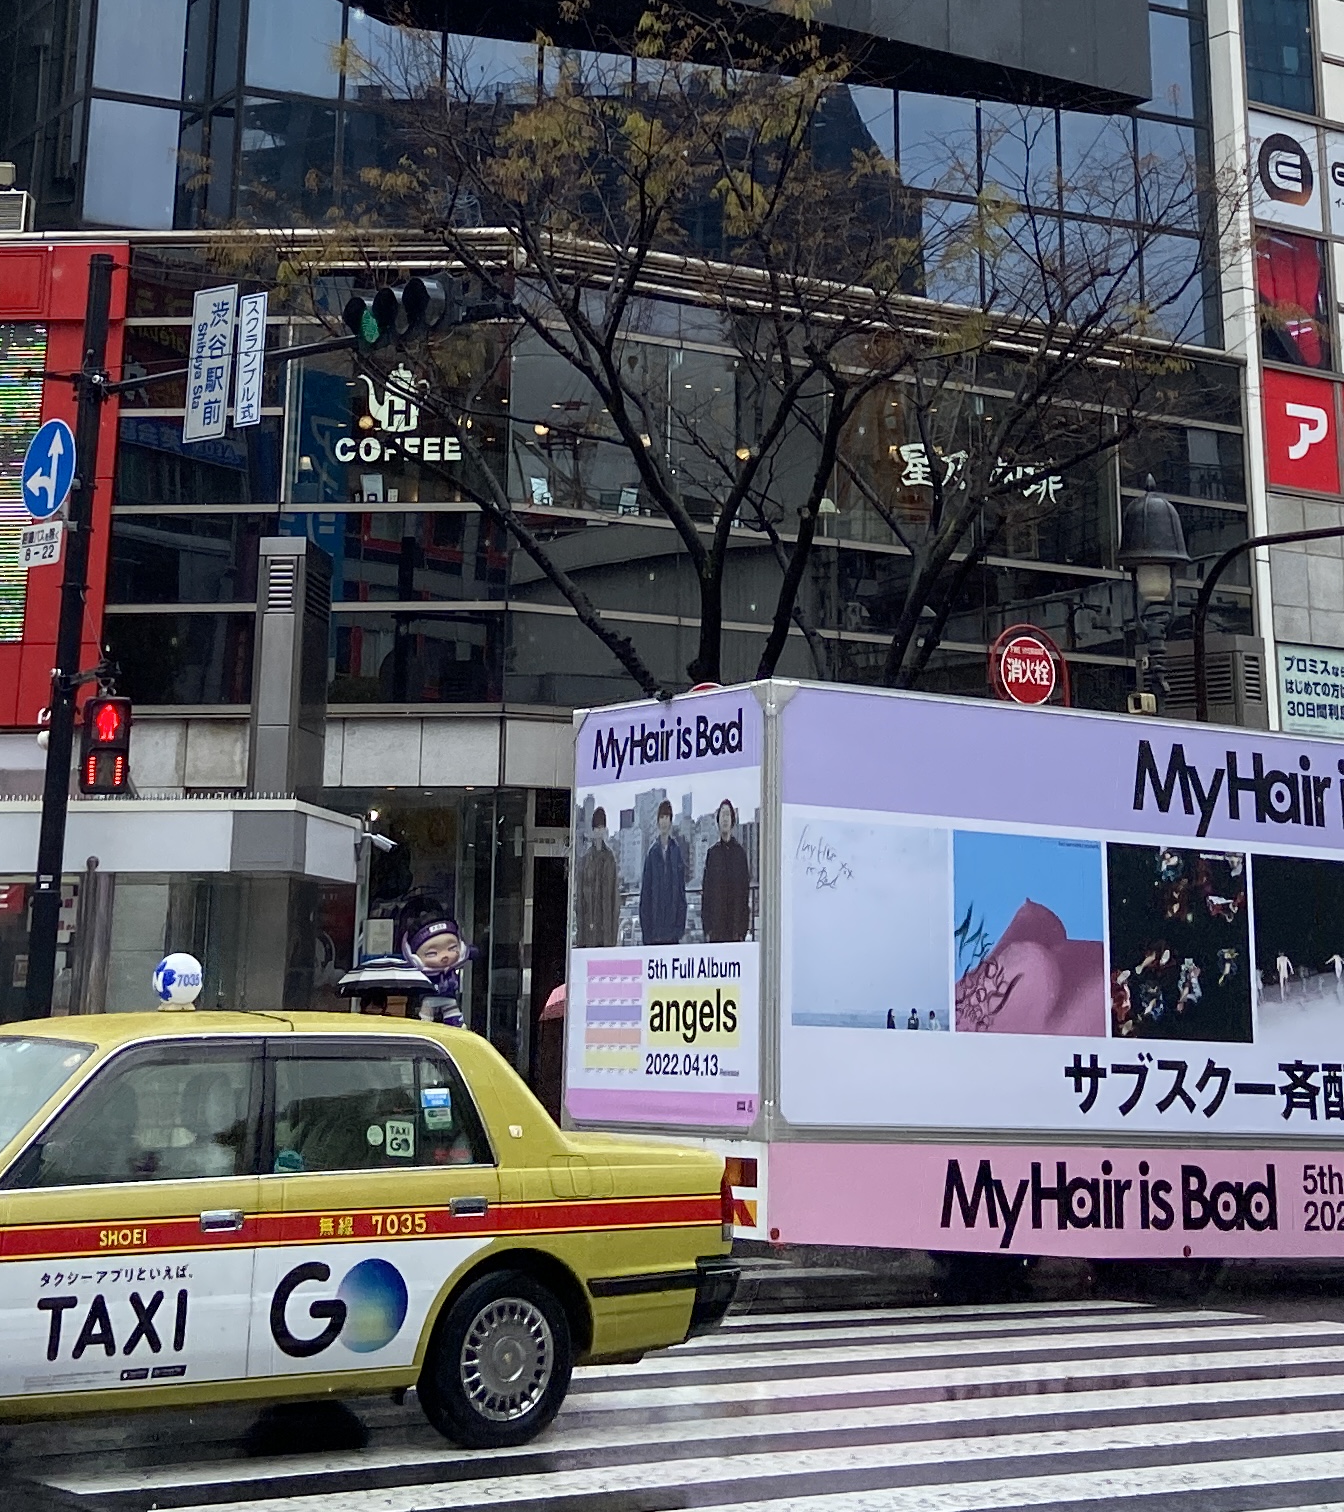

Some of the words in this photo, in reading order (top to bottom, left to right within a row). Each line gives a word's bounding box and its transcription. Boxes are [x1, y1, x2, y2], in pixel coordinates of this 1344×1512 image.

[193, 322, 209, 381] Shibuya
[202, 299, 230, 427] 渋谷駅前
[240, 300, 260, 421] スクランブル式
[335, 437, 463, 464] COFFEE
[1006, 657, 1051, 686] 消火栓
[676, 720, 693, 760] is
[696, 706, 745, 759] Bad
[176, 973, 201, 988] 7035
[646, 958, 669, 980] 5th
[671, 956, 696, 980] Full
[697, 956, 742, 980] Album
[649, 988, 738, 1044] angels
[645, 1053, 720, 1077] 2022.04.13
[389, 1125, 411, 1137] TAXI
[1302, 1164, 1344, 1195] 5th
[1139, 1159, 1176, 1232] is
[1181, 1163, 1280, 1233] Bad
[99, 1229, 148, 1248] SHOEI
[318, 1216, 355, 1237] 無線
[370, 1213, 428, 1236] 7035
[36, 1288, 189, 1362] TAXI
